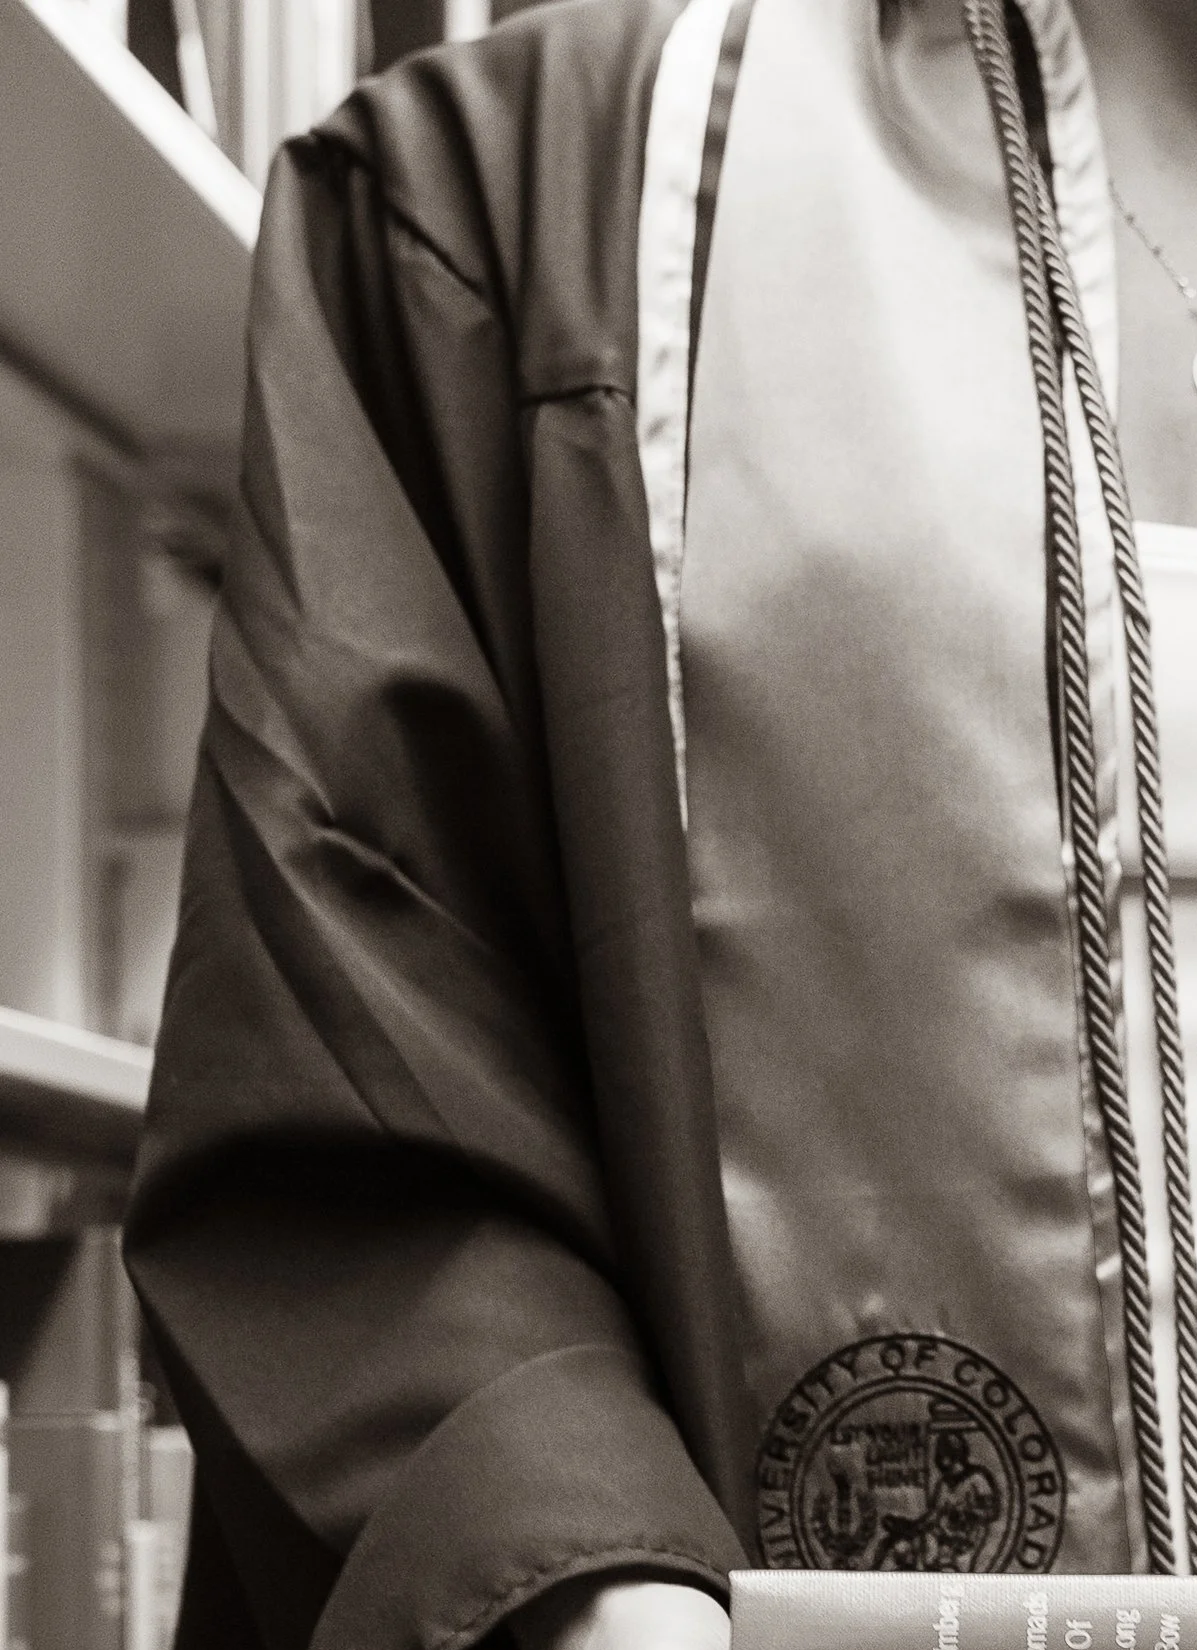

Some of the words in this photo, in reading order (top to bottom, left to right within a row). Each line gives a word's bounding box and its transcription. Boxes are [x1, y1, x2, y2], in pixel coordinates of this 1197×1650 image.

[761, 1347, 857, 1569] IVERSITY
[880, 1343, 938, 1374] OF
[953, 1359, 1059, 1570] COLORAD
[1064, 1618, 1093, 1650] Of
